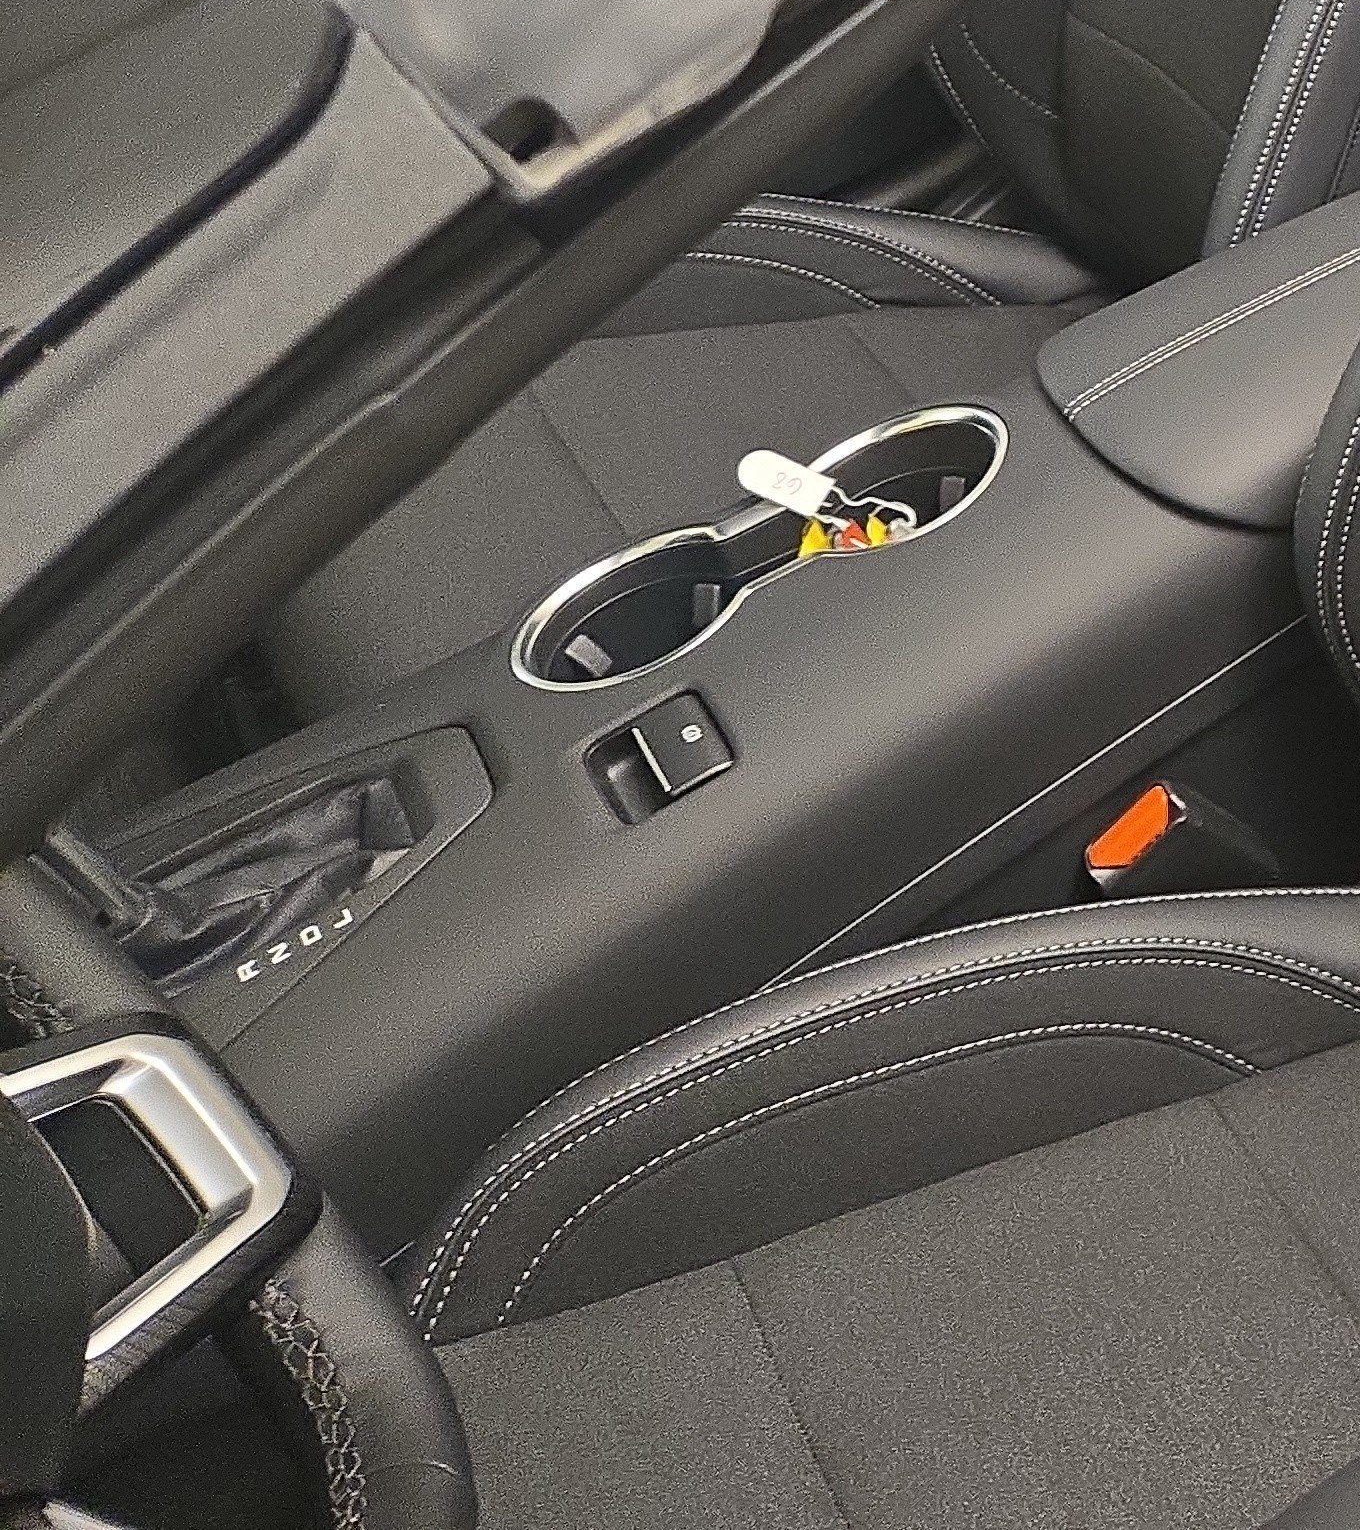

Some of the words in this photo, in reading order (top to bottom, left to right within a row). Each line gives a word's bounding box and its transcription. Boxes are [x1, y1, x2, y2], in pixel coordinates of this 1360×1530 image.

[236, 959, 261, 983] R
[266, 942, 292, 965] N
[299, 925, 323, 946] D
